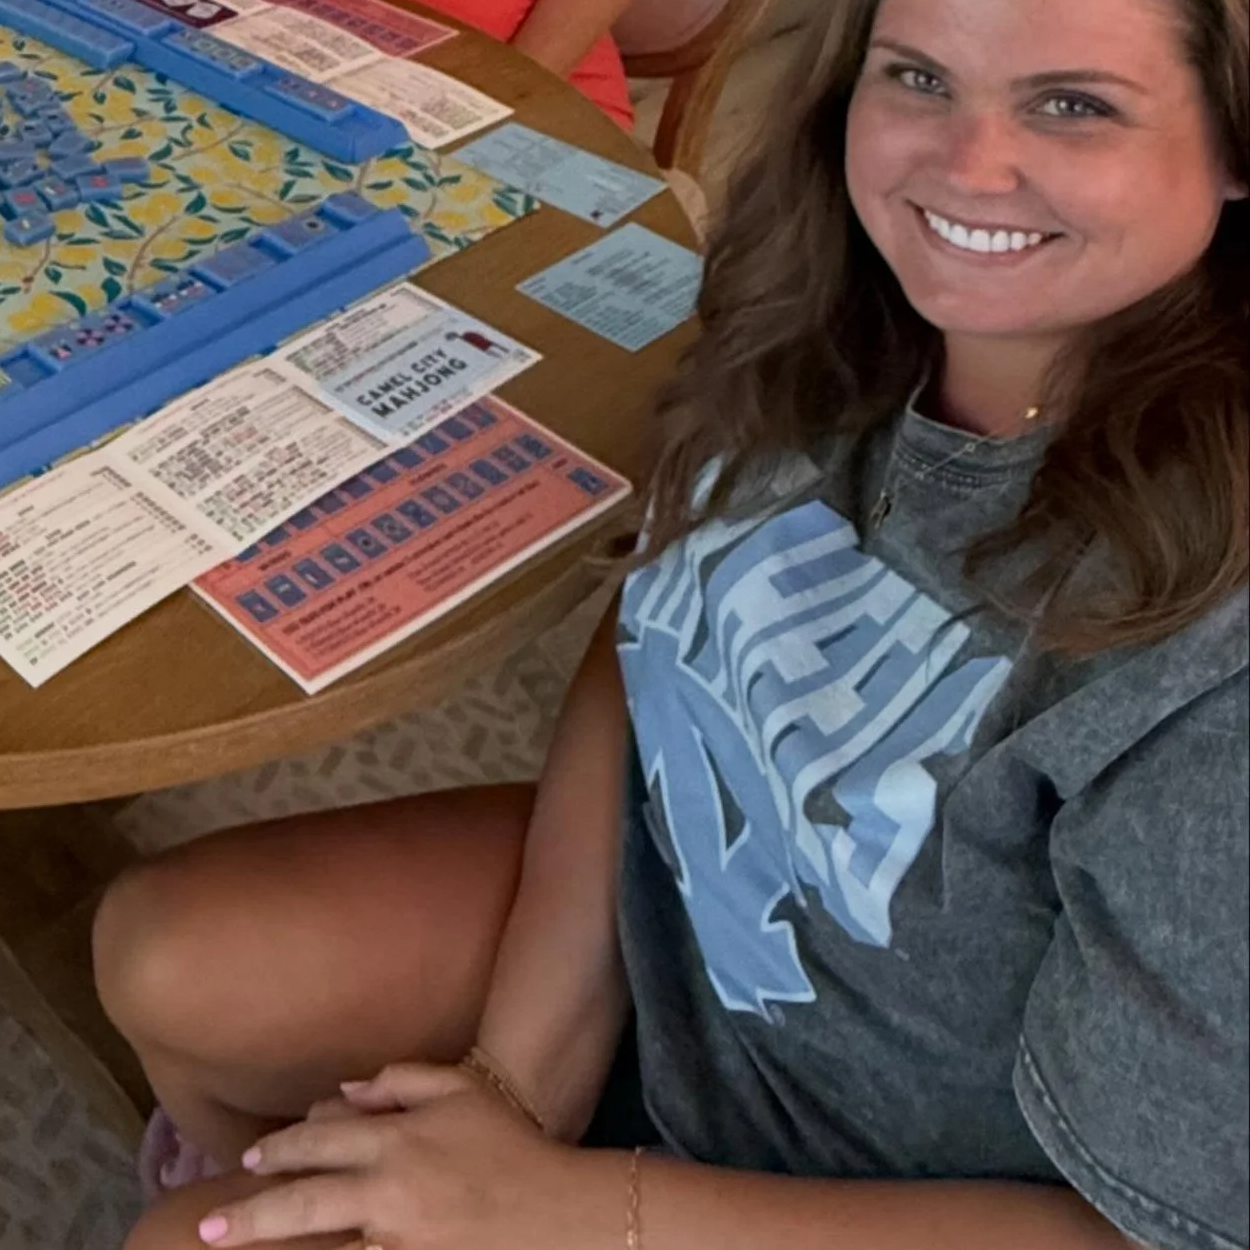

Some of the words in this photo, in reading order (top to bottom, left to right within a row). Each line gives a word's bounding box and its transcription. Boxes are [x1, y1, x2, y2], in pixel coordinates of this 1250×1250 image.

[356, 372, 412, 406] CAMEL
[410, 346, 447, 373] CITY
[371, 357, 468, 418] MAHJONG
